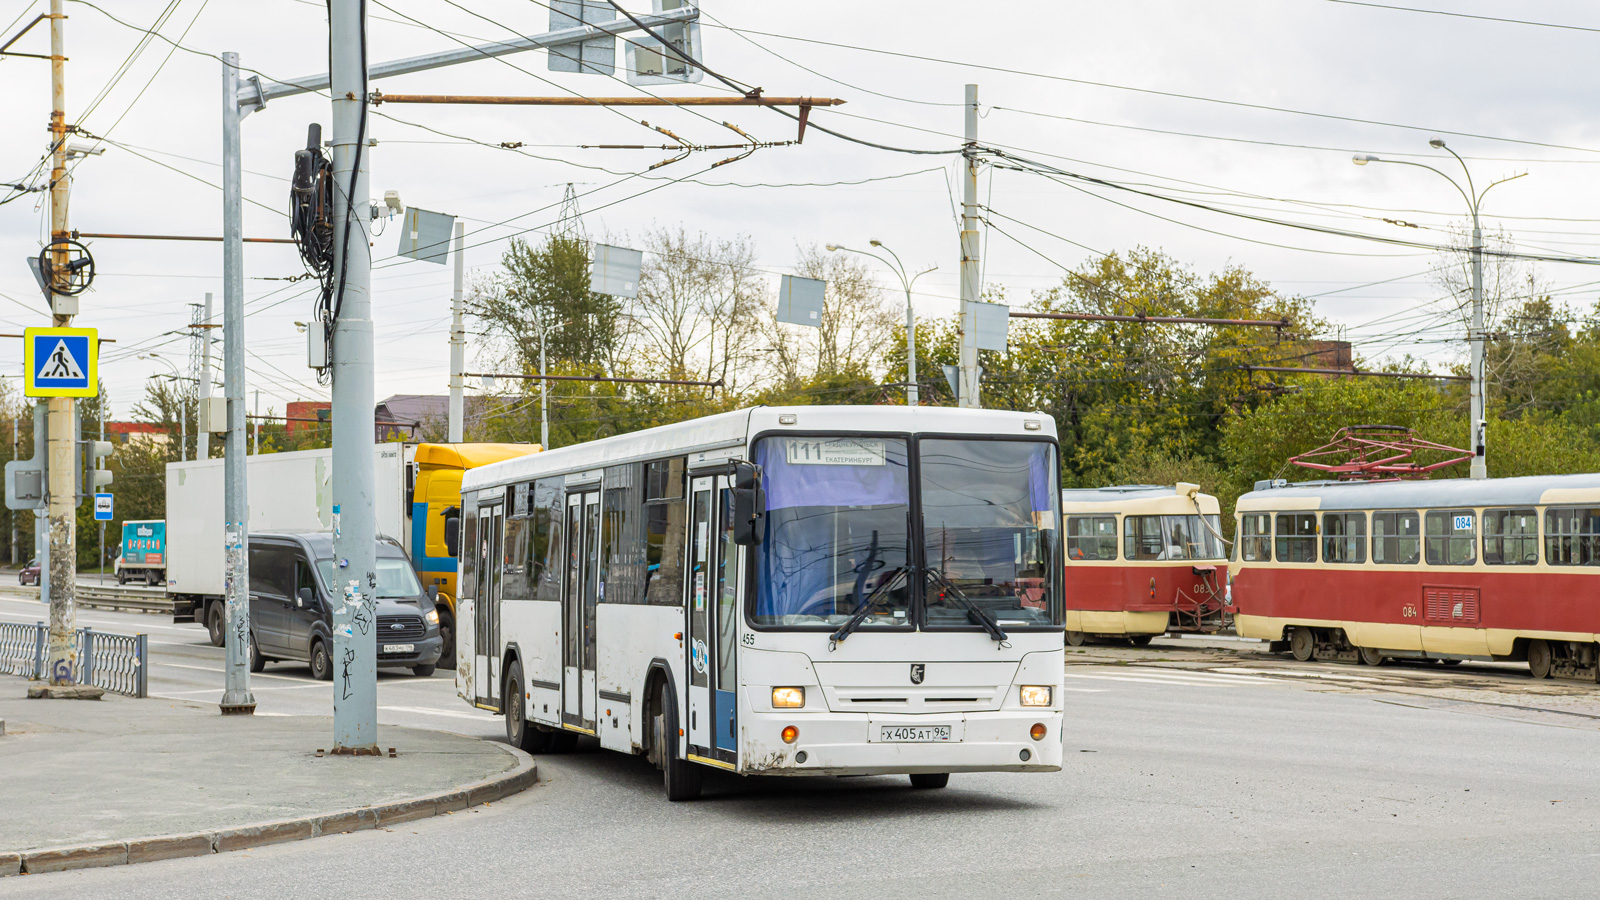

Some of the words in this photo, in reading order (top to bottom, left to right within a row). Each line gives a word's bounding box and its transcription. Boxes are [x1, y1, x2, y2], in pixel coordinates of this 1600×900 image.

[790, 441, 821, 461] 111
[1456, 517, 1471, 529] 084
[1403, 606, 1417, 618] 084
[743, 633, 755, 645] 455
